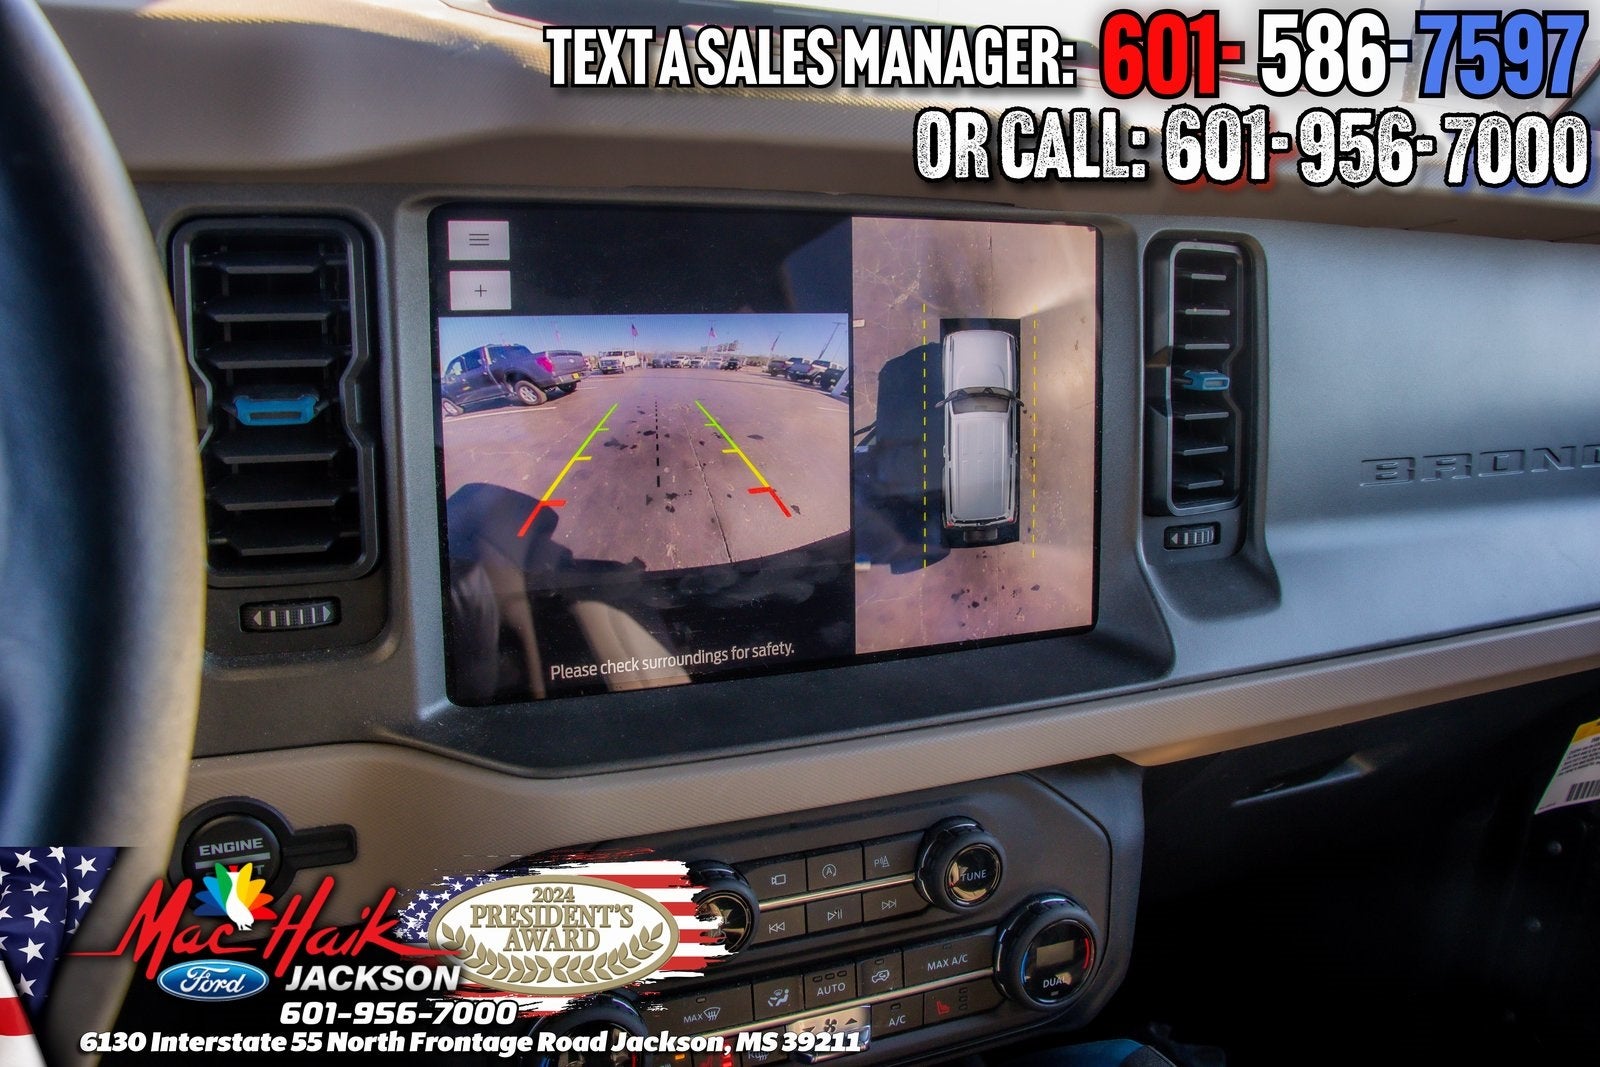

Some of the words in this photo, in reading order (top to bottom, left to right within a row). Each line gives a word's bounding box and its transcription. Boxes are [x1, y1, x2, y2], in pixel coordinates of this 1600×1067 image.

[550, 664, 598, 680] Please
[600, 657, 640, 675] check
[642, 650, 729, 670] surroundings
[731, 645, 750, 661] for
[752, 641, 796, 659] safety.
[199, 837, 264, 857] ENGINE
[961, 869, 987, 882] TUNE
[927, 960, 949, 972] MAX
[951, 953, 969, 966] A/C
[816, 982, 847, 997] AUTO
[1043, 976, 1068, 989] DUAL
[683, 1013, 704, 1024] MAX
[888, 1014, 907, 1027] A/C
